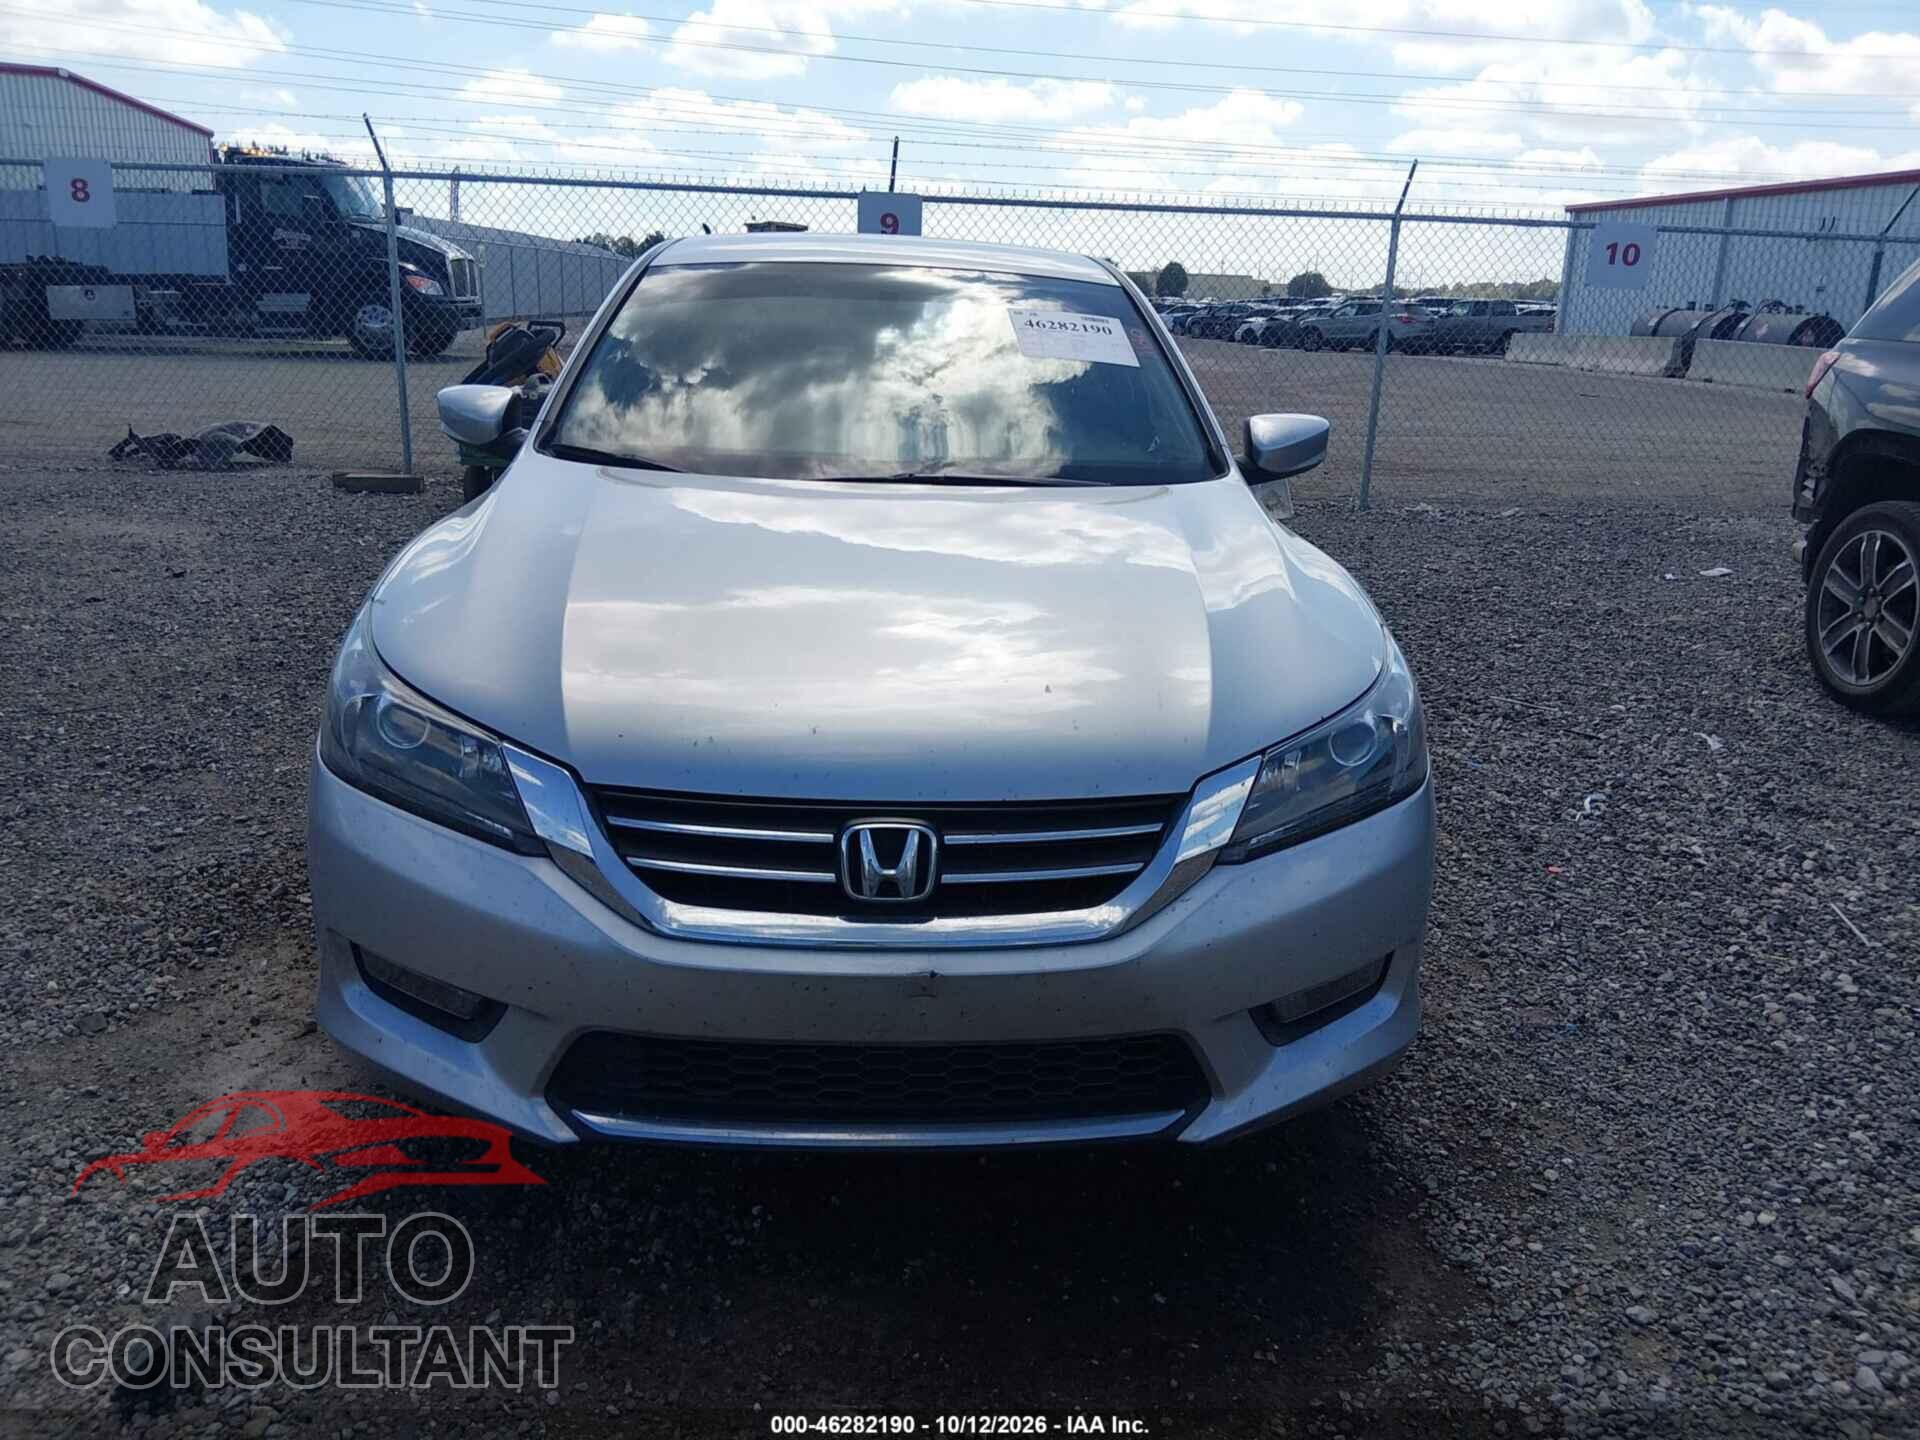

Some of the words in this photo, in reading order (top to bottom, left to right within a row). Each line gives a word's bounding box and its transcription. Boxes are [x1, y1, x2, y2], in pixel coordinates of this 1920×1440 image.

[71, 178, 90, 202] 8
[880, 212, 899, 234] 9
[1605, 242, 1641, 266] 10
[1024, 319, 1112, 335] 46282190
